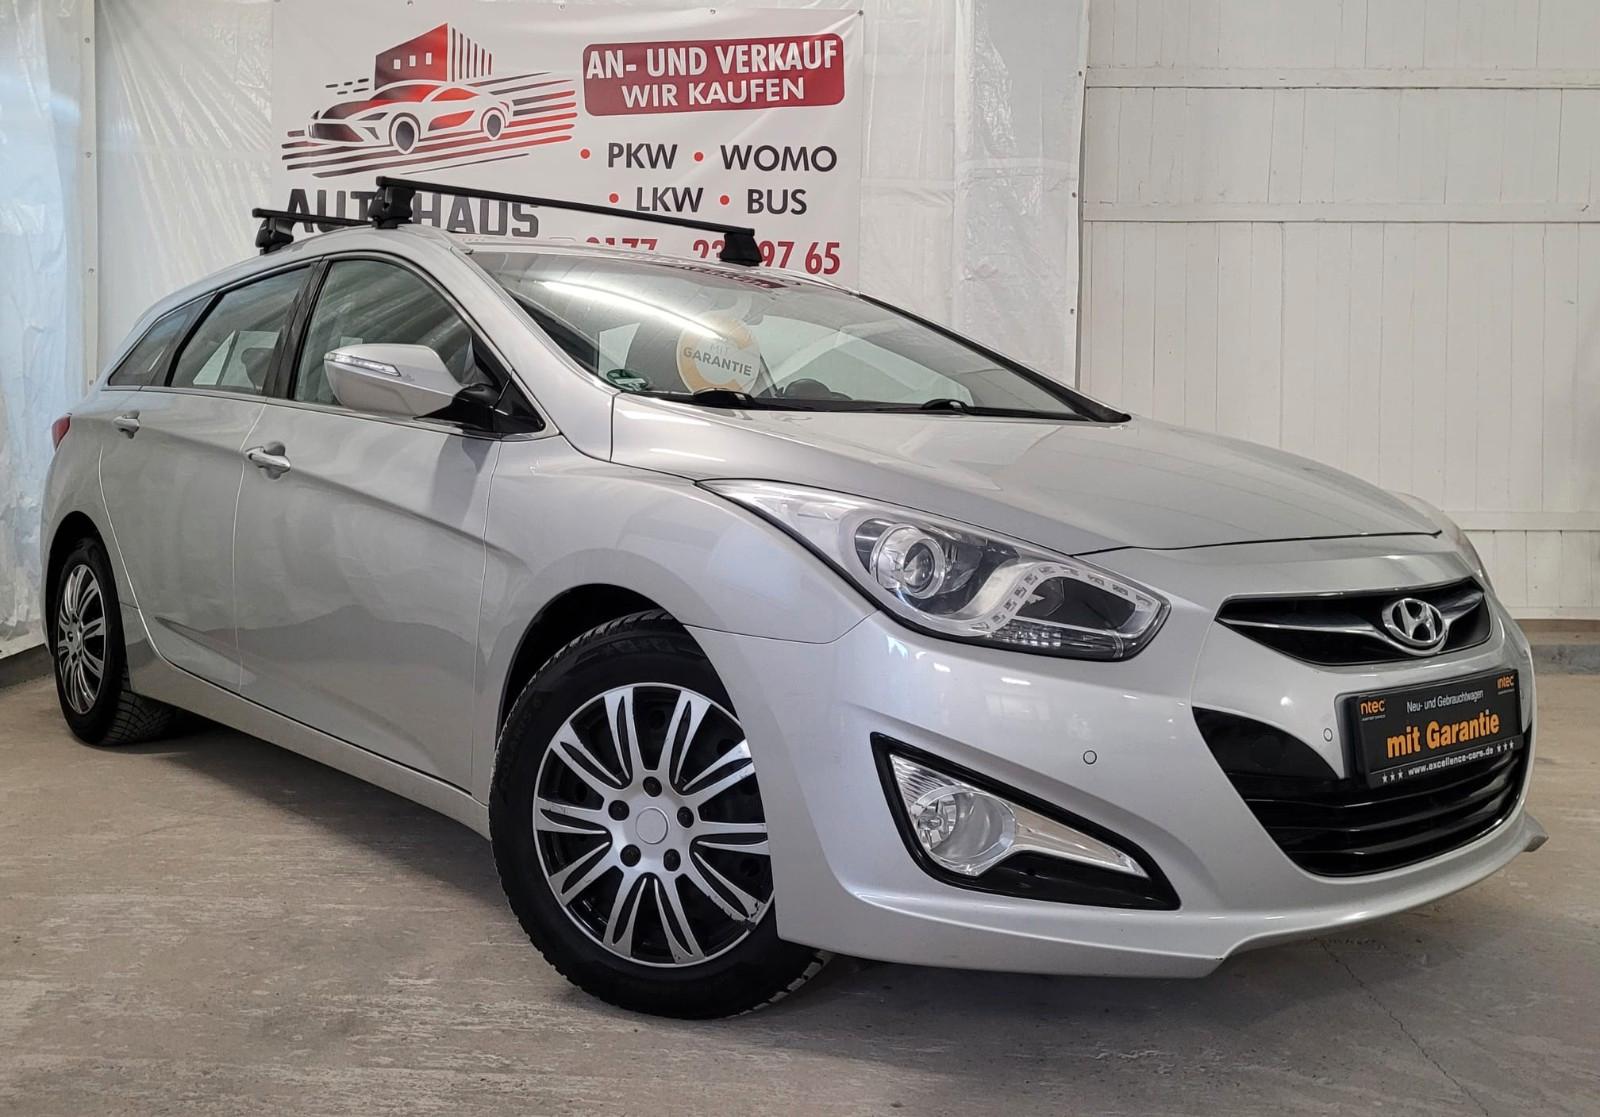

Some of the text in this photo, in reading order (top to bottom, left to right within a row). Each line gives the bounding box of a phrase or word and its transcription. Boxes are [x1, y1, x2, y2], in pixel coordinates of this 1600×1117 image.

[586, 39, 838, 80] AN- UND VERKAUF
[620, 76, 805, 109] WIR KAUFEN
[607, 142, 838, 172] PKW WOMO
[287, 188, 539, 238] AUTHAUS
[635, 186, 808, 216] LKW BUS
[758, 240, 795, 269] 97
[804, 241, 841, 275] 65
[683, 346, 753, 377] GARANTIE
[1406, 701, 1424, 714] Neu-
[1424, 696, 1437, 710] und
[1437, 689, 1484, 705] Gebrauchtwagen
[1387, 709, 1499, 759] mit Garantie
[1407, 746, 1495, 776] www.excellence-cars.de
